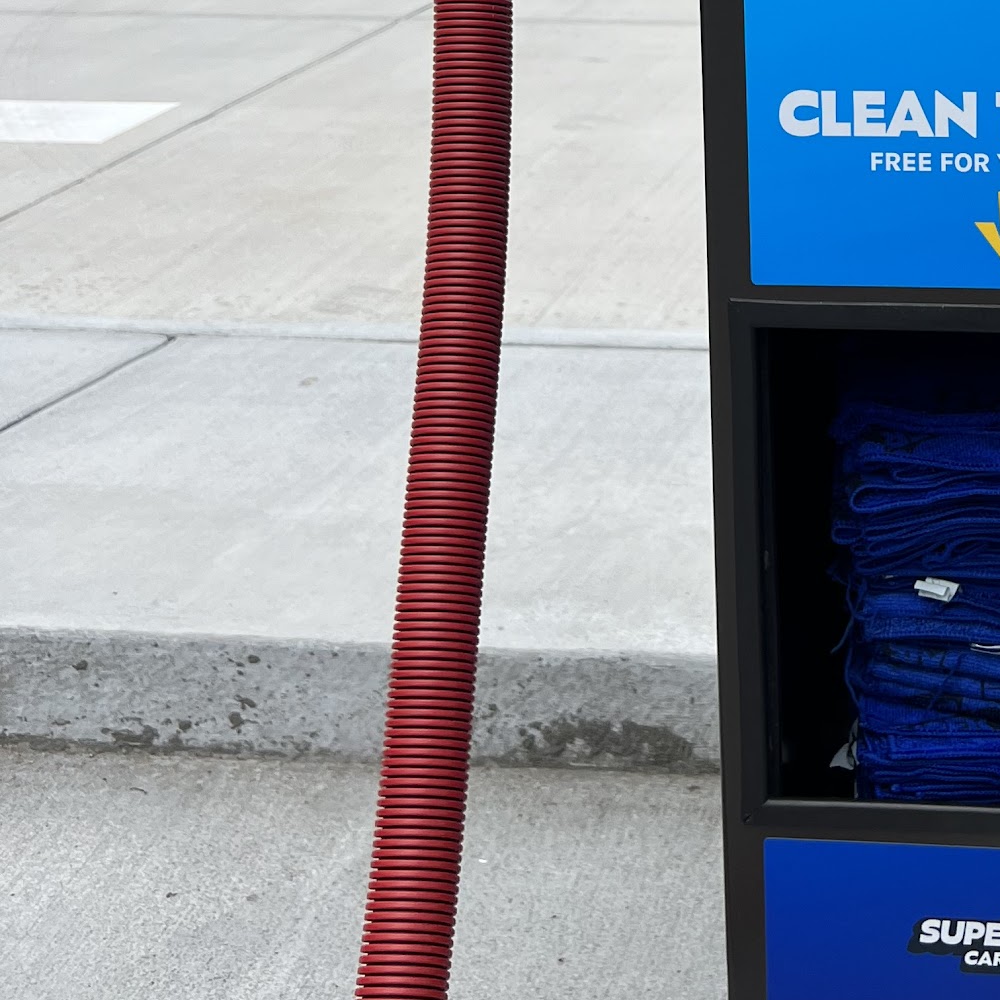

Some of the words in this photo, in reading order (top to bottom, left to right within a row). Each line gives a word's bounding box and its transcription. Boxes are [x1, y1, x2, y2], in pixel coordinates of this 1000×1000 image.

[778, 89, 977, 139] CLEAN
[870, 152, 932, 172] FREE
[940, 153, 990, 173] FOR
